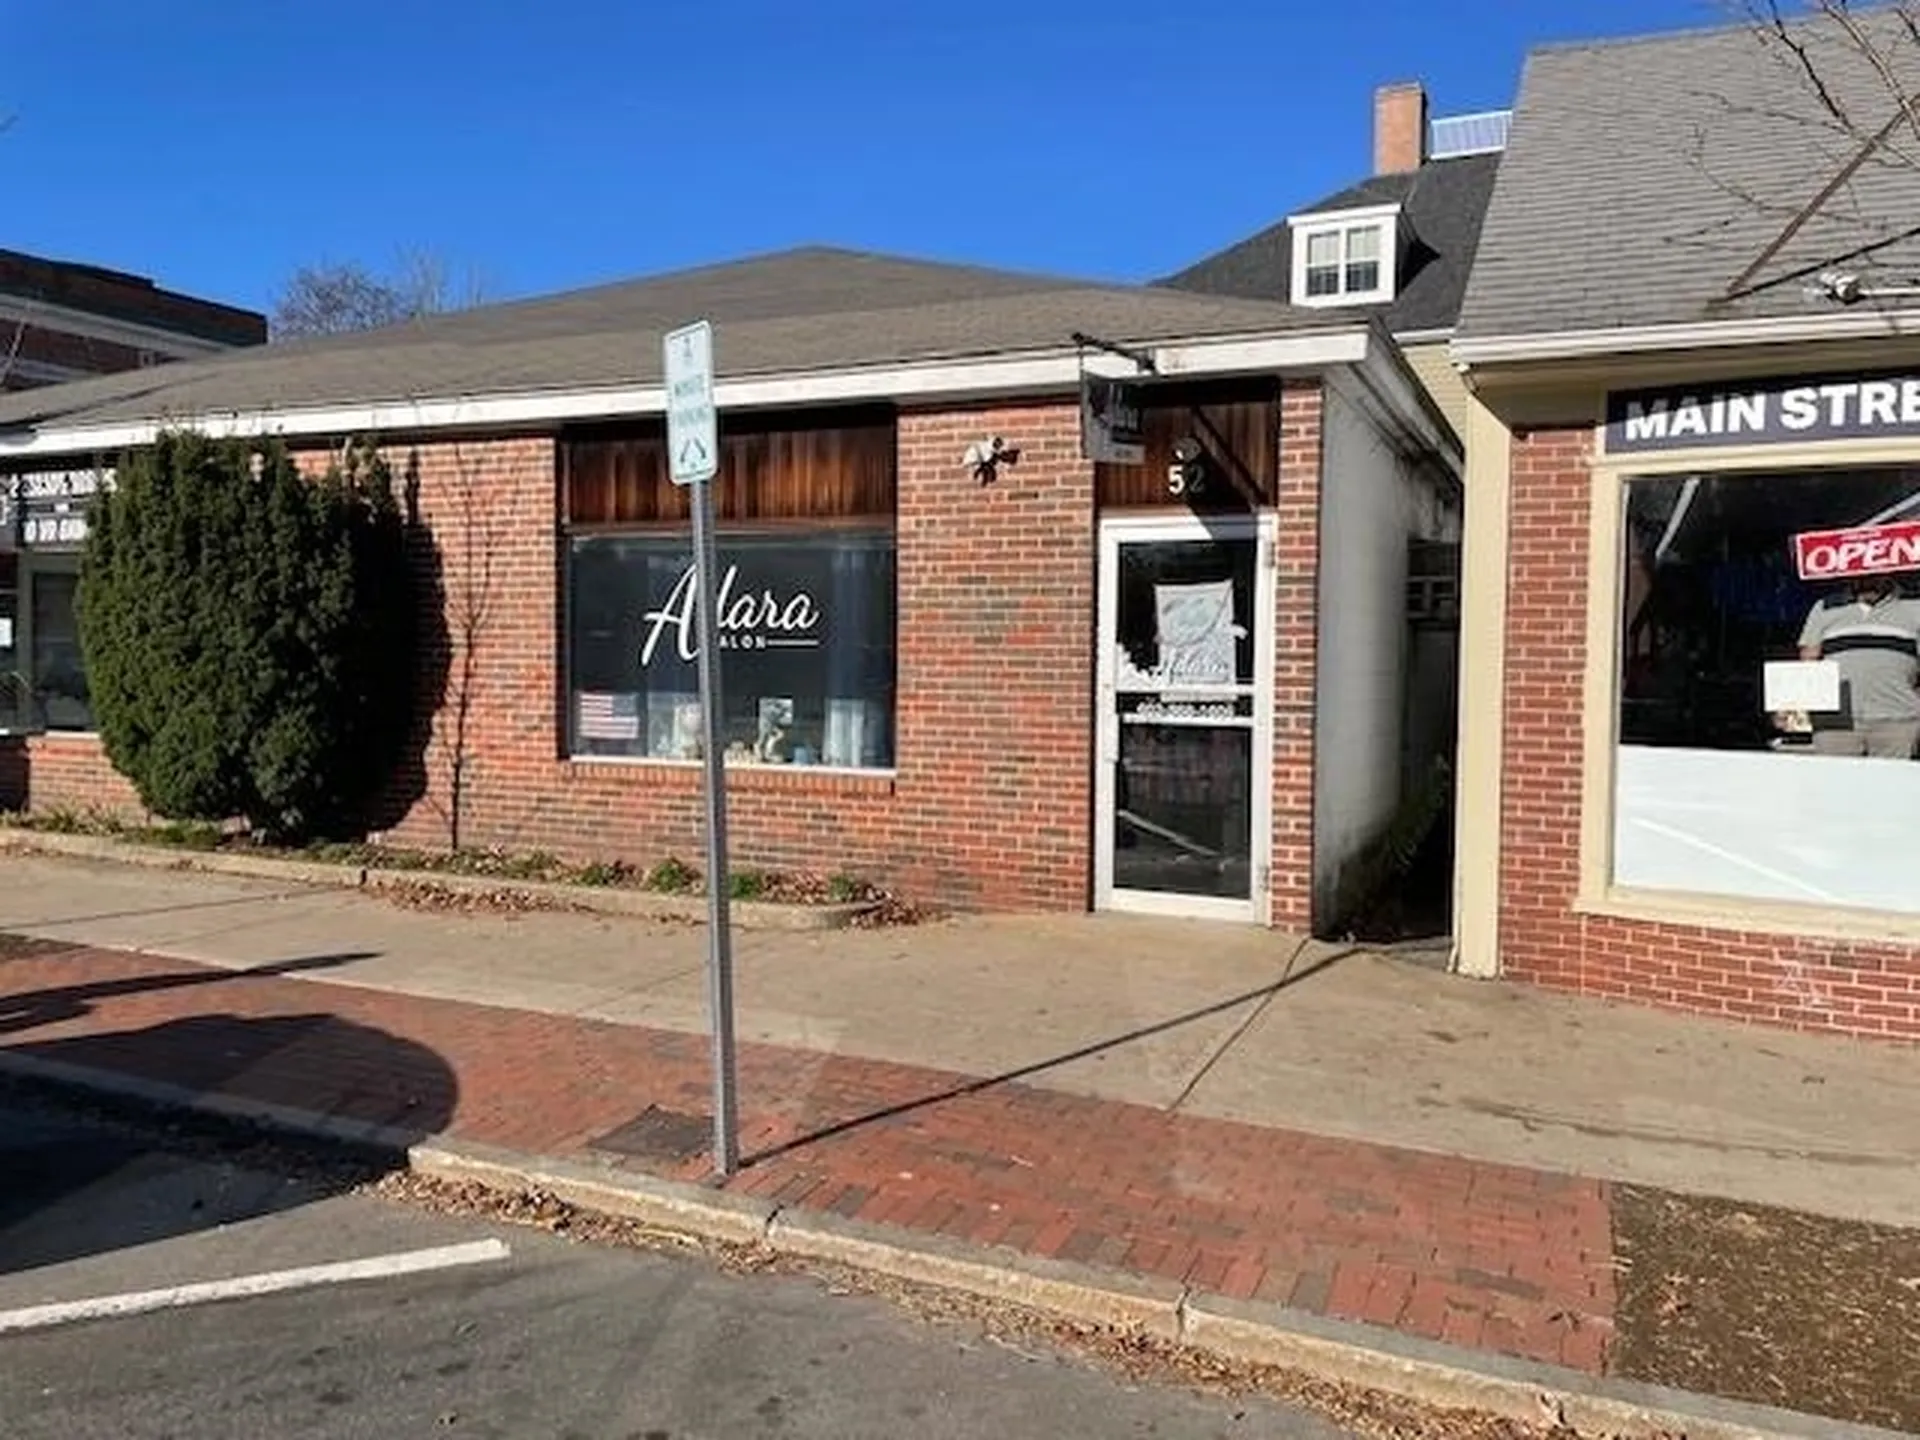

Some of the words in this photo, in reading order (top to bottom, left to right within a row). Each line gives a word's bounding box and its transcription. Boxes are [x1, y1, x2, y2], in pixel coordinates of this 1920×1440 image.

[1625, 394, 1767, 440] MAIN
[1168, 464, 1205, 494] 52
[1805, 534, 1920, 573] OPEN
[719, 634, 766, 650] ALON
